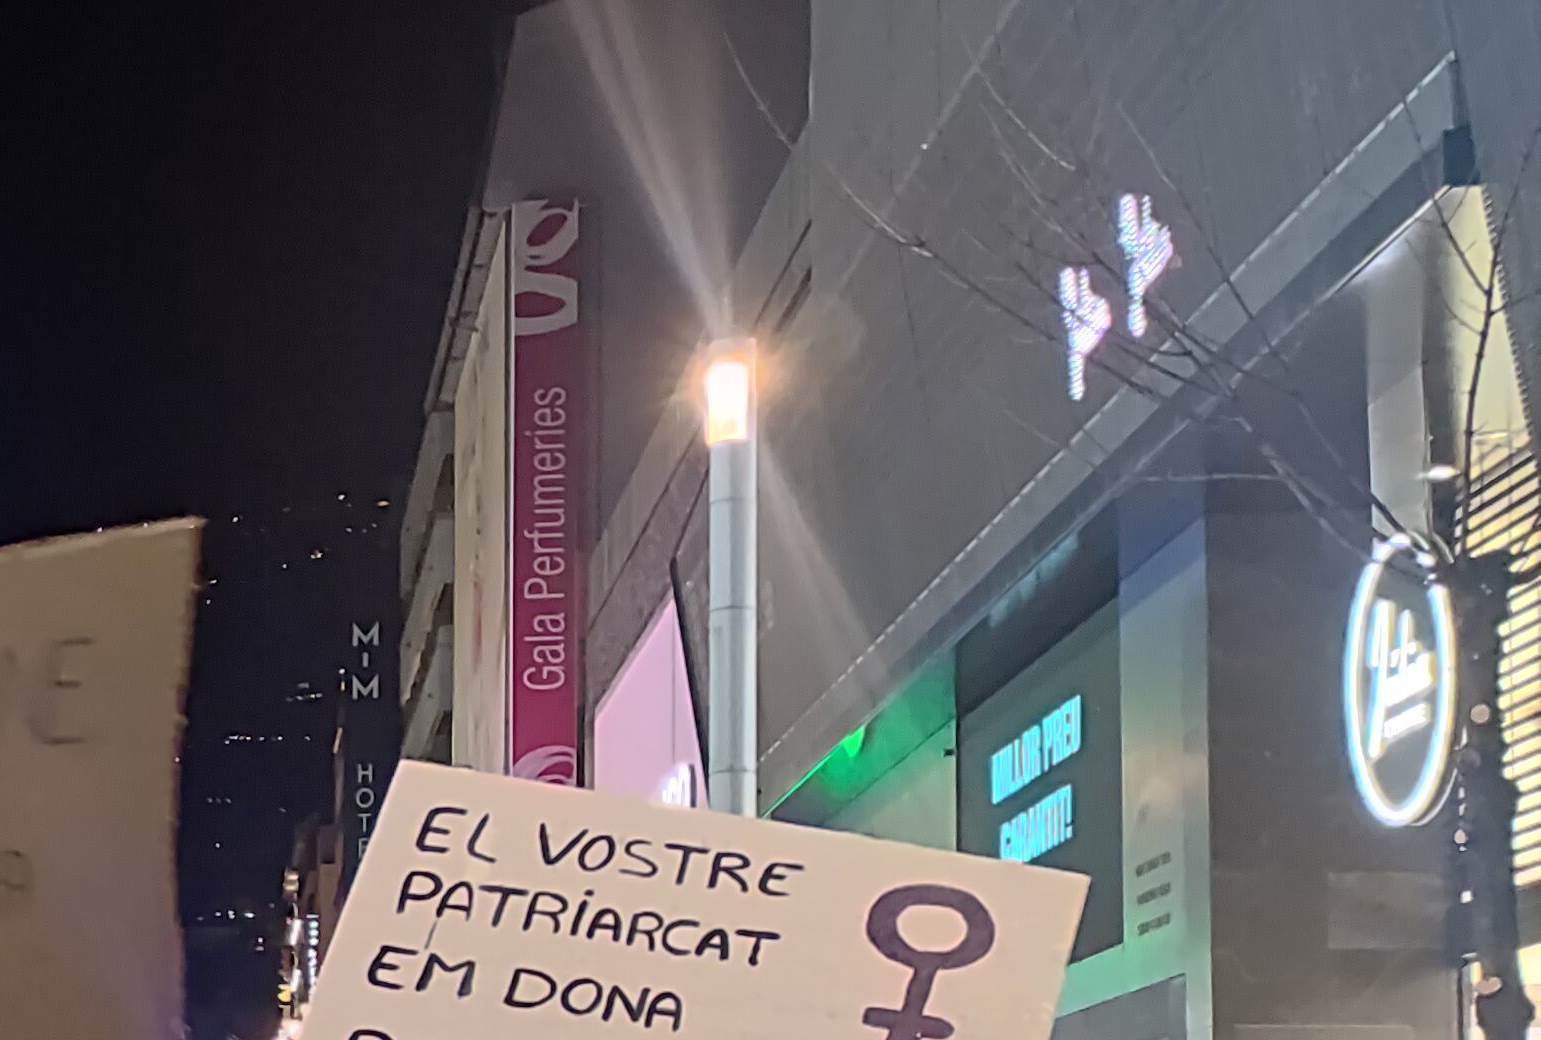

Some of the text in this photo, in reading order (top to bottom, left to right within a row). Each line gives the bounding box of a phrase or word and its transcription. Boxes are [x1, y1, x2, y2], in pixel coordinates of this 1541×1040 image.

[523, 386, 566, 598] Perfumeries
[523, 609, 565, 692] Gala
[416, 806, 805, 897] EL VOSTRE
[368, 944, 684, 1032] EM DONA
